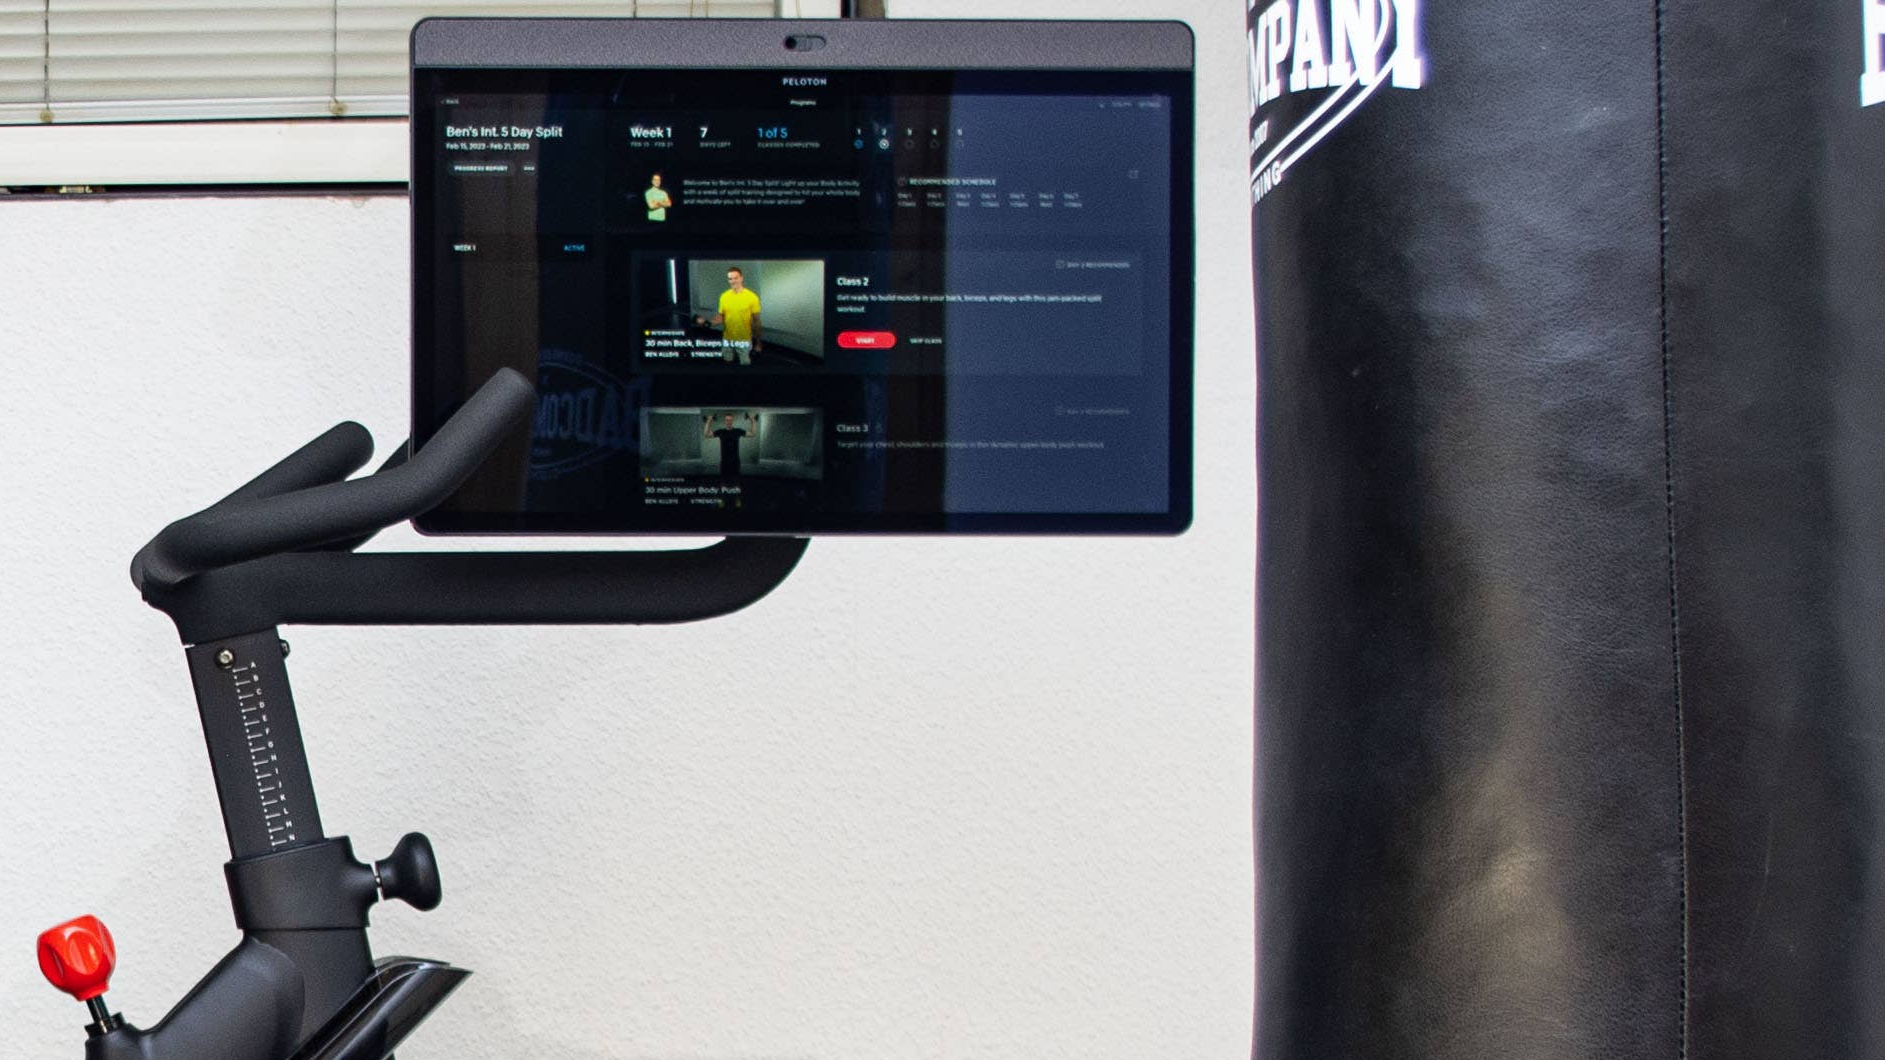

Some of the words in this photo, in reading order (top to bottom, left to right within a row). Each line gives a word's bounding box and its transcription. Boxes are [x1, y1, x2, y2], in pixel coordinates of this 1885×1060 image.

[782, 77, 828, 87] PELOTON
[446, 126, 478, 138] Ben's
[501, 126, 509, 138] 5
[511, 126, 533, 139] Day
[535, 125, 563, 139] Split
[629, 127, 664, 138] Week
[666, 127, 672, 138] 1
[699, 127, 708, 138] 7
[757, 127, 763, 139] 1
[765, 127, 778, 139] of
[780, 127, 788, 139] 5
[837, 277, 861, 286] Class
[863, 277, 869, 286] 2
[645, 340, 655, 348] 30
[657, 340, 672, 348] min
[695, 340, 722, 348] Biceps
[730, 340, 750, 348] Legs
[836, 424, 861, 432] Class
[862, 424, 868, 432] 3
[645, 486, 655, 495] 30
[657, 486, 672, 495] min
[673, 486, 696, 495] Upper
[698, 486, 718, 495] Body
[721, 486, 741, 495] Push
